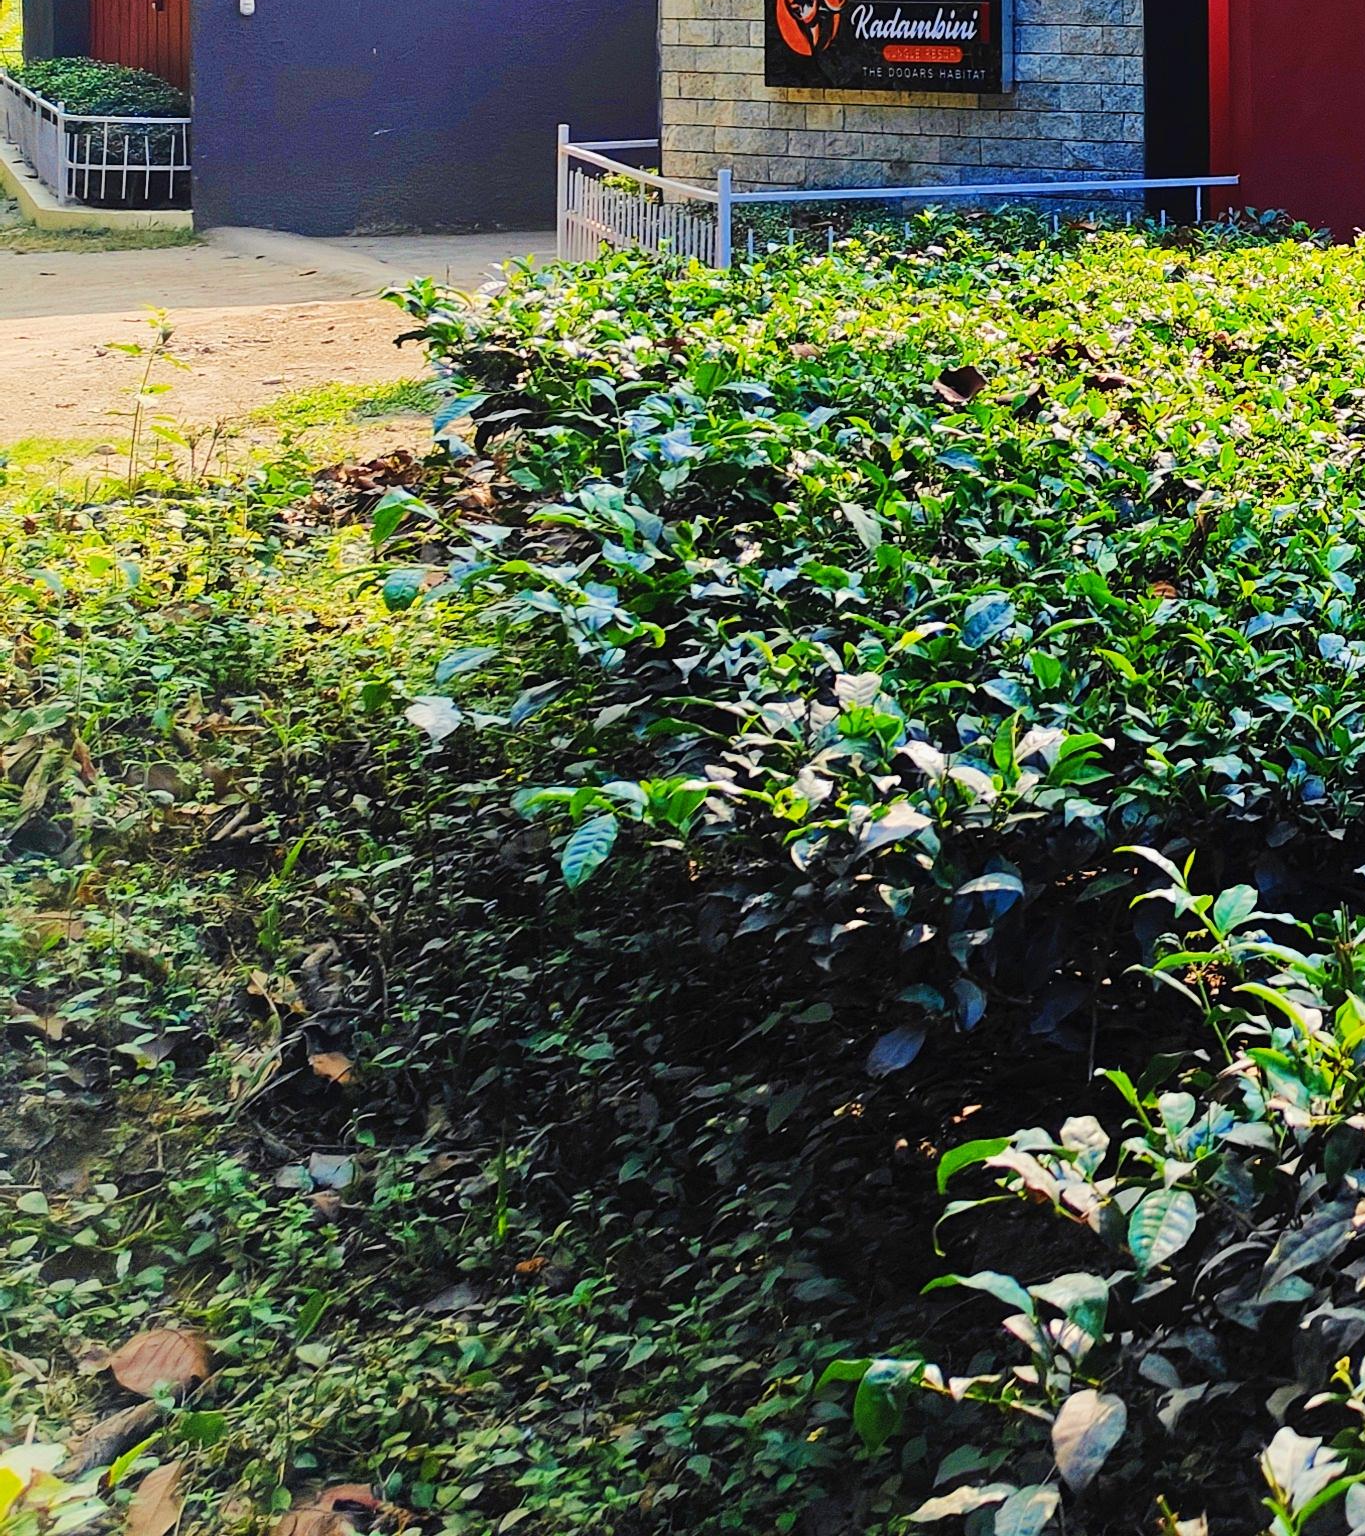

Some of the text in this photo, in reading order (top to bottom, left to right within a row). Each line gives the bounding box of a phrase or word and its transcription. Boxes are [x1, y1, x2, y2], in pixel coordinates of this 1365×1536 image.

[851, 4, 979, 40] Kadambini
[862, 66, 883, 78] THE
[939, 68, 987, 81] HABITAT
